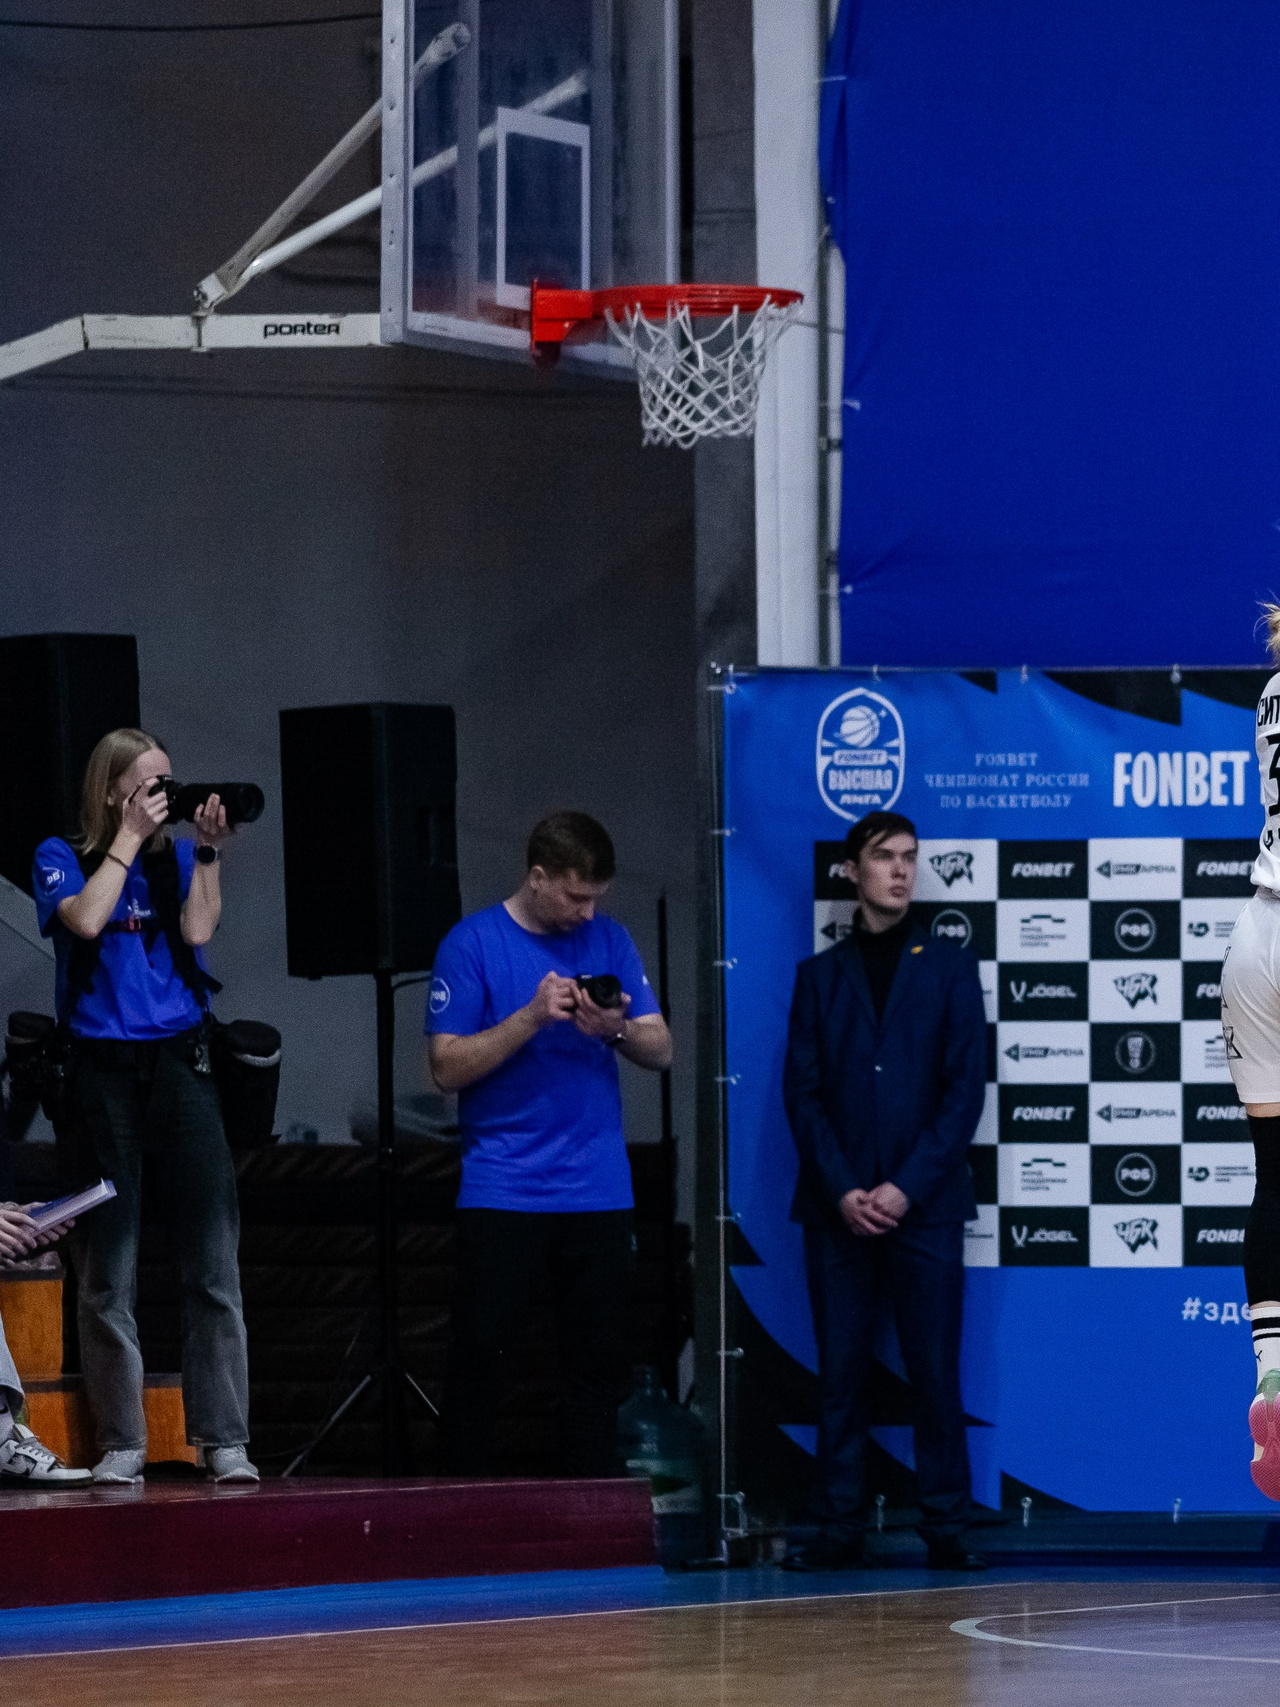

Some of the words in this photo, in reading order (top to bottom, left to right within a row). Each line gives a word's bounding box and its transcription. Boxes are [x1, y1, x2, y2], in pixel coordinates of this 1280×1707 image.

[974, 752, 1038, 767] FONBET
[1025, 772, 1090, 788] РОССИИ
[1112, 750, 1251, 808] FONBET
[940, 794, 962, 809] ПО
[1011, 862, 1076, 878] FONBET
[1012, 1105, 1076, 1121] FONBET
[1197, 1104, 1248, 1120] FONBE
